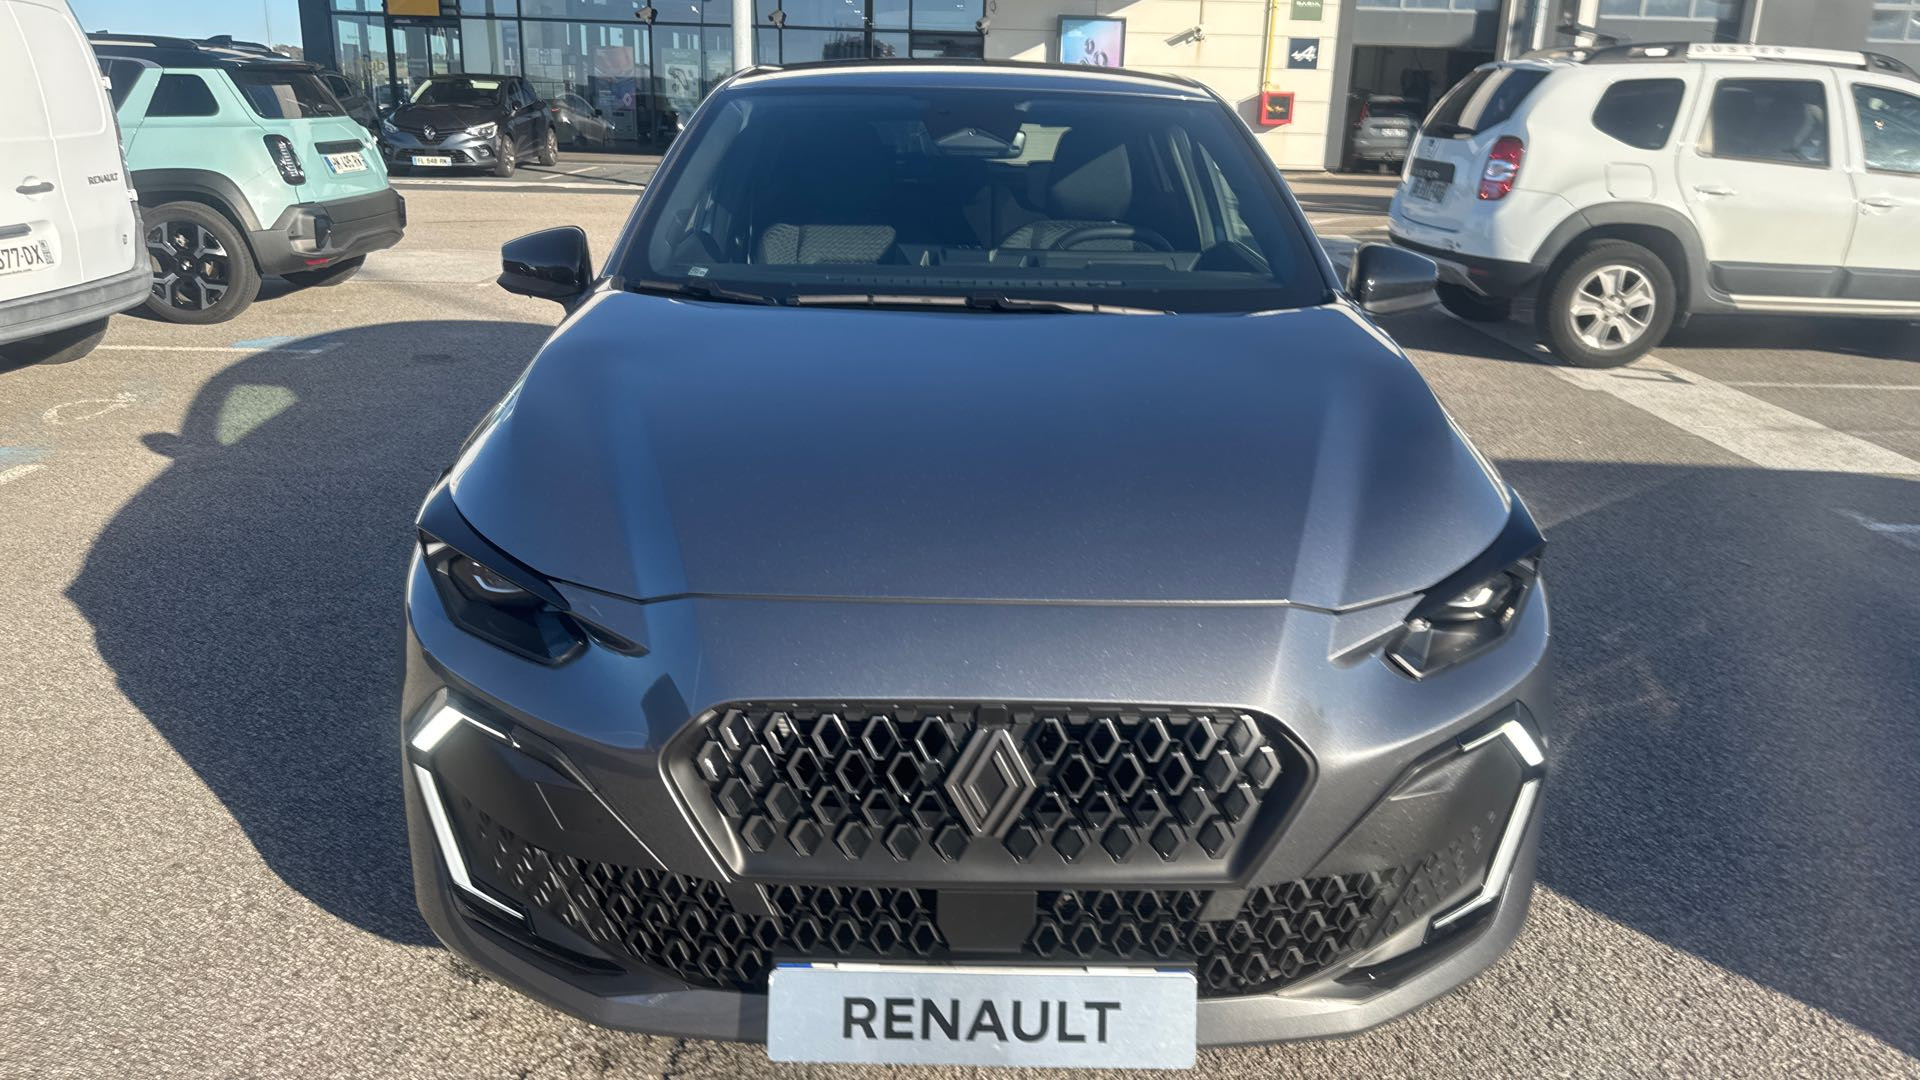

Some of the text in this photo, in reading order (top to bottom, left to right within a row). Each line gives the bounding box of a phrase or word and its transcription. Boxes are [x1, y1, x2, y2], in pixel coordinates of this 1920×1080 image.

[1695, 44, 1786, 55] DUSTER
[88, 172, 119, 185] RENAULT
[842, 996, 1122, 1044] RENAULT
